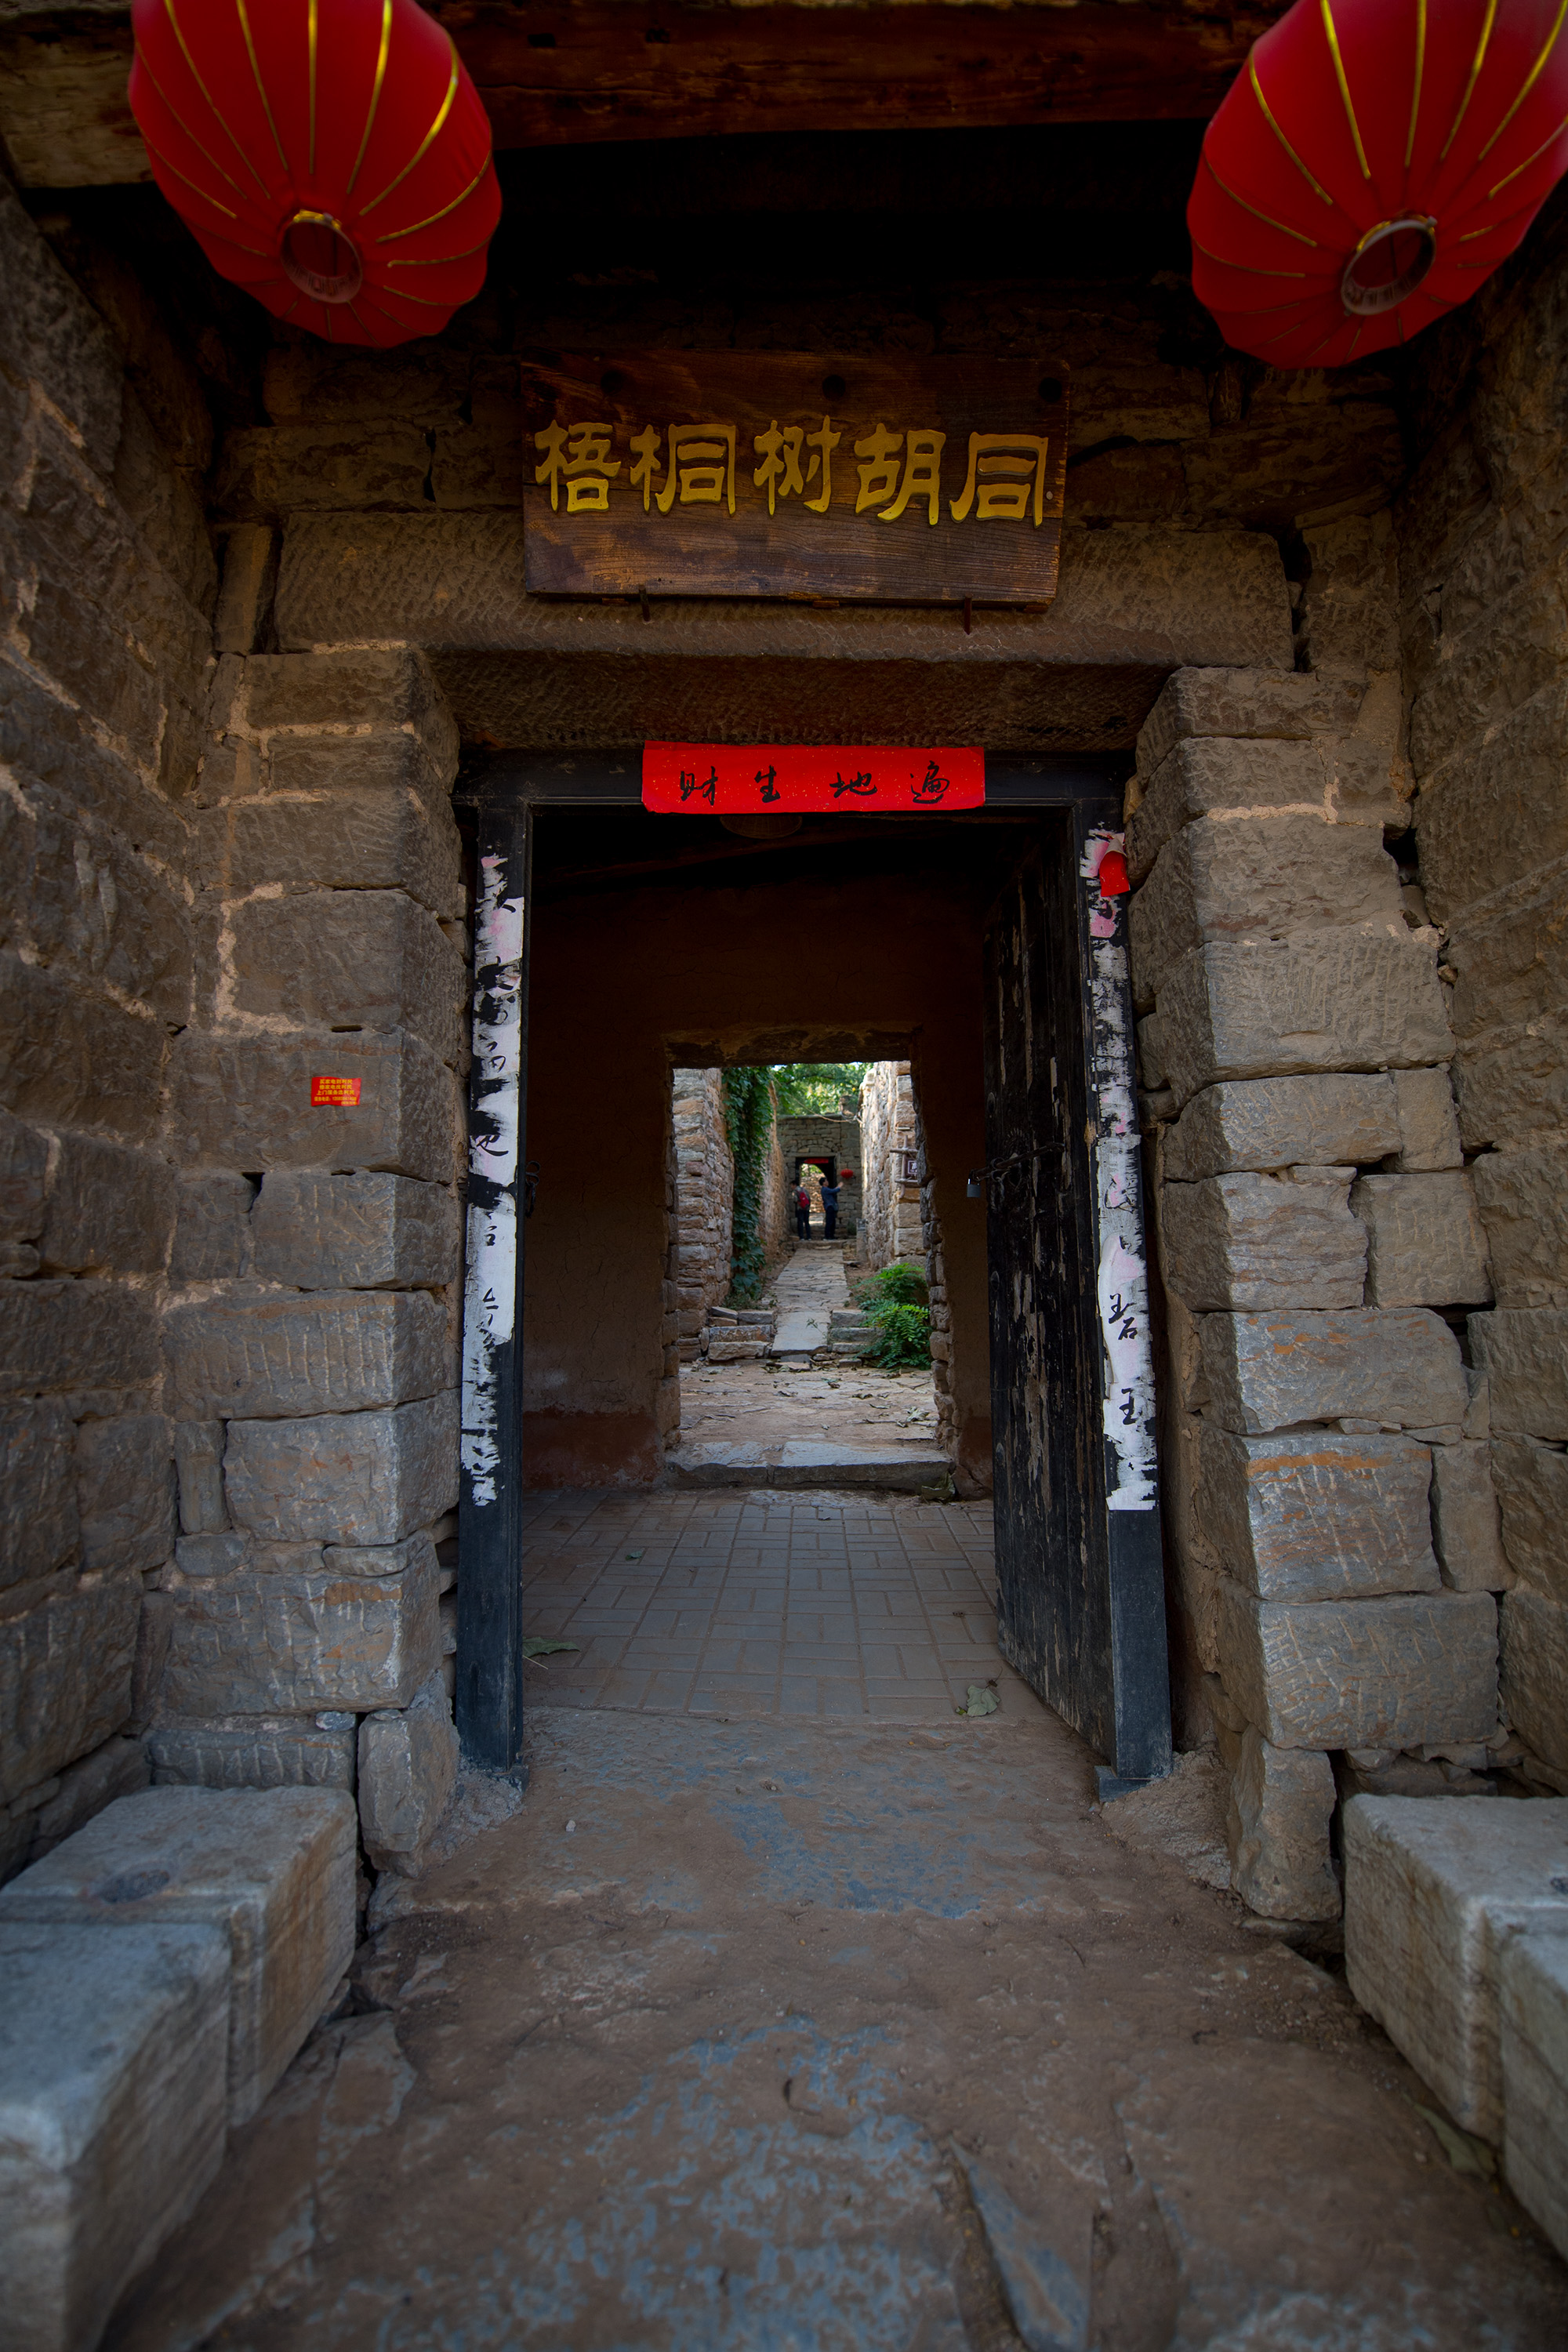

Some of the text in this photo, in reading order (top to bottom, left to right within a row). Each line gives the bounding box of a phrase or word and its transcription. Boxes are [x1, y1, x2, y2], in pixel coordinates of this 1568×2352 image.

[535, 415, 1048, 528] 梧桐树胡同
